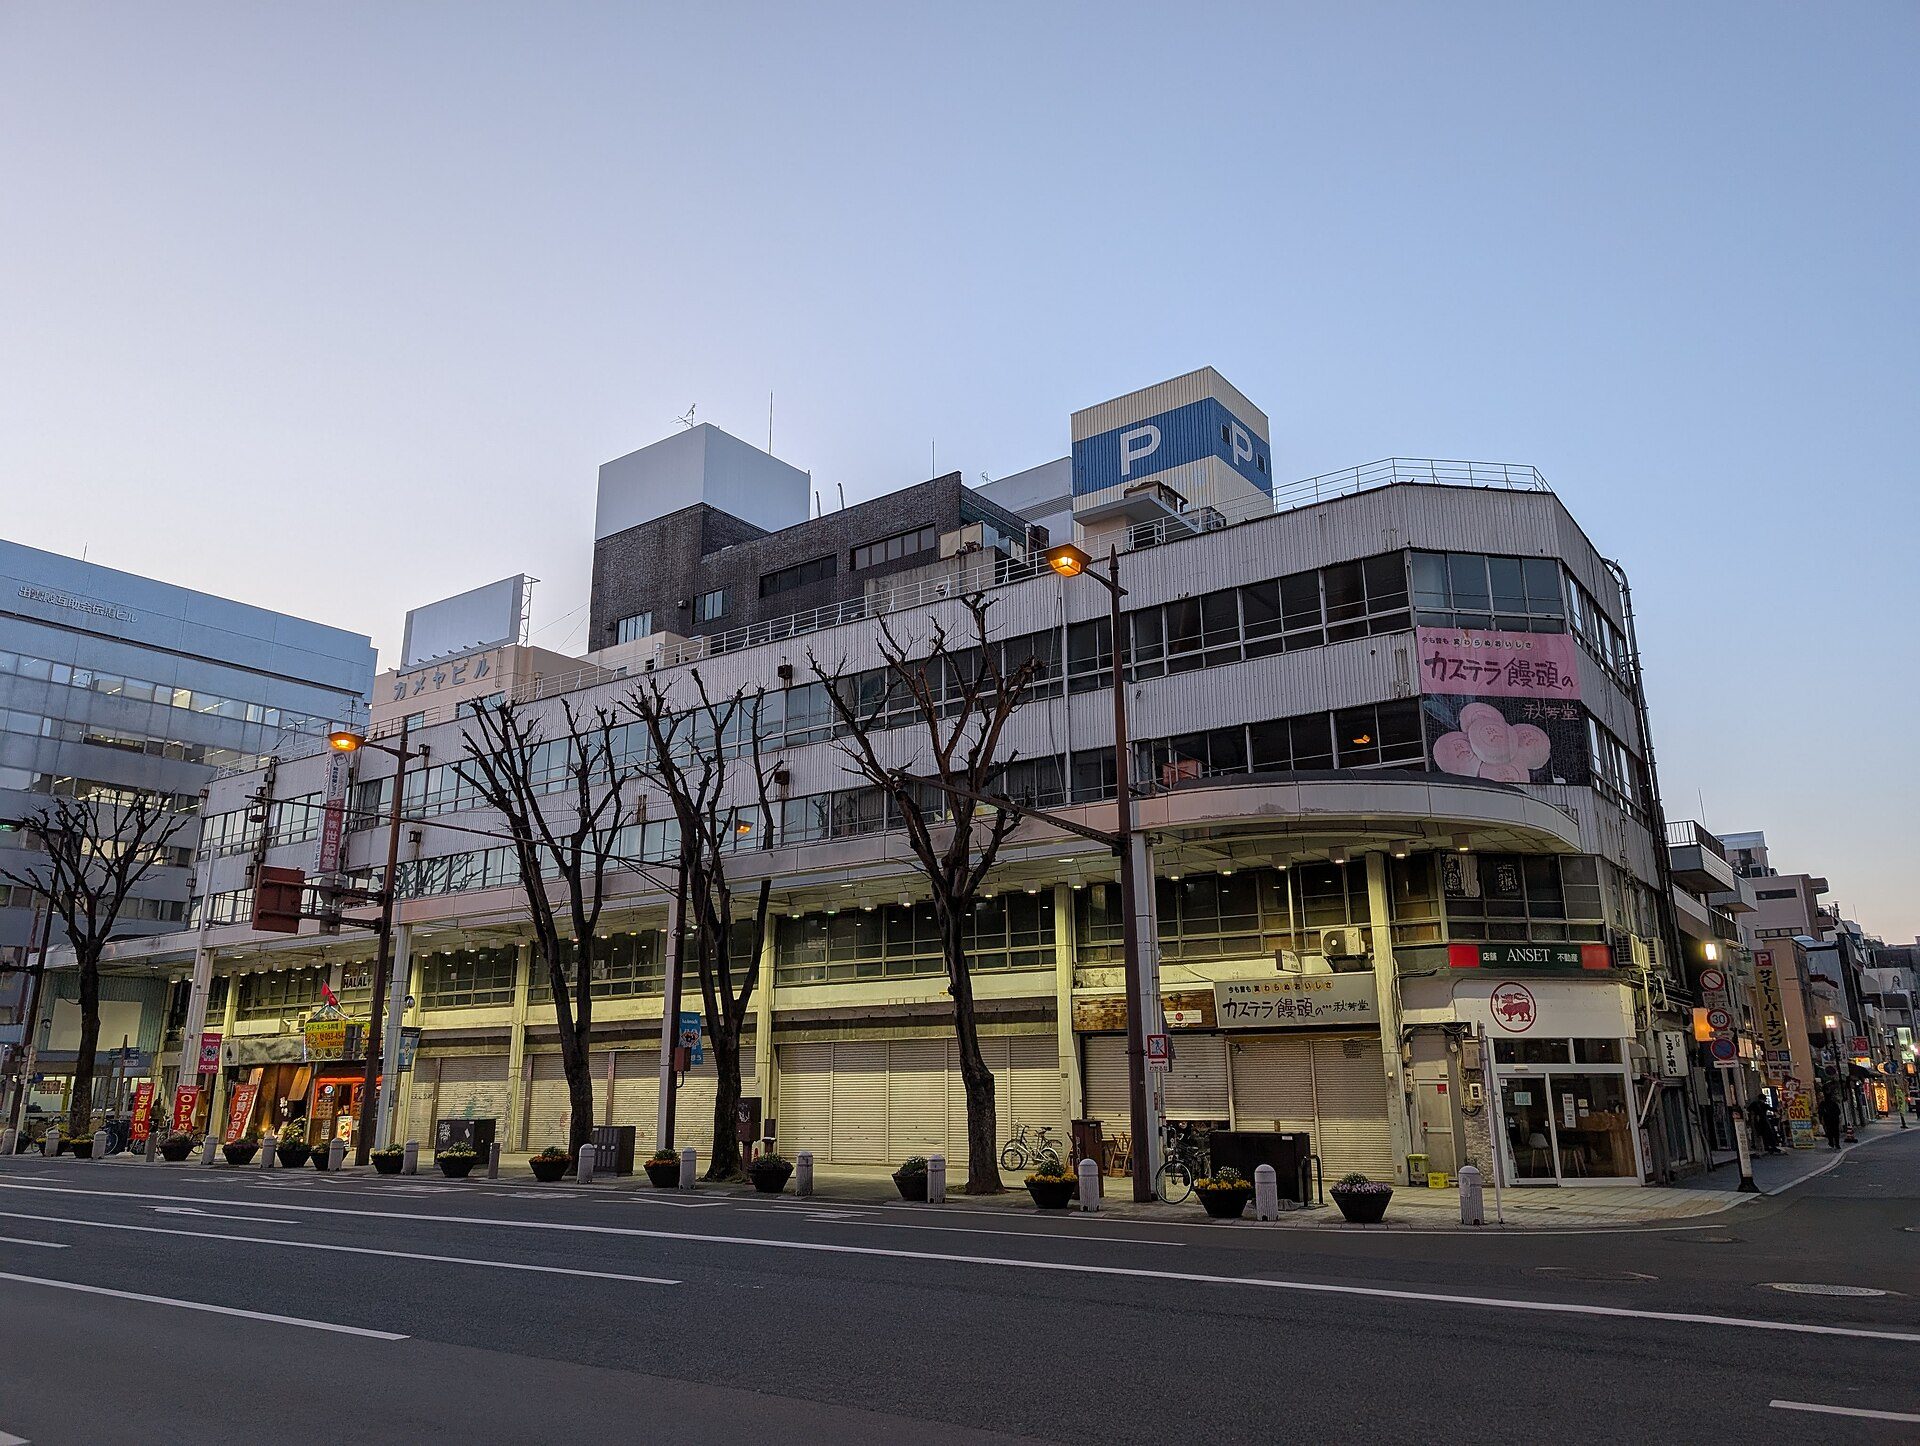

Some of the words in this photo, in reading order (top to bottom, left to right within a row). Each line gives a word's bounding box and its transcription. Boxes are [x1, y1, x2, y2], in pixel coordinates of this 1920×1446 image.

[1120, 425, 1161, 476] P
[1231, 420, 1253, 466] P
[393, 658, 491, 701] カメヤビル
[1424, 651, 1574, 690] カステラ饅頭の
[1507, 948, 1551, 962] ANSET
[1757, 953, 1770, 965] P
[1712, 1014, 1726, 1024] 30
[178, 1094, 193, 1130] OPEN
